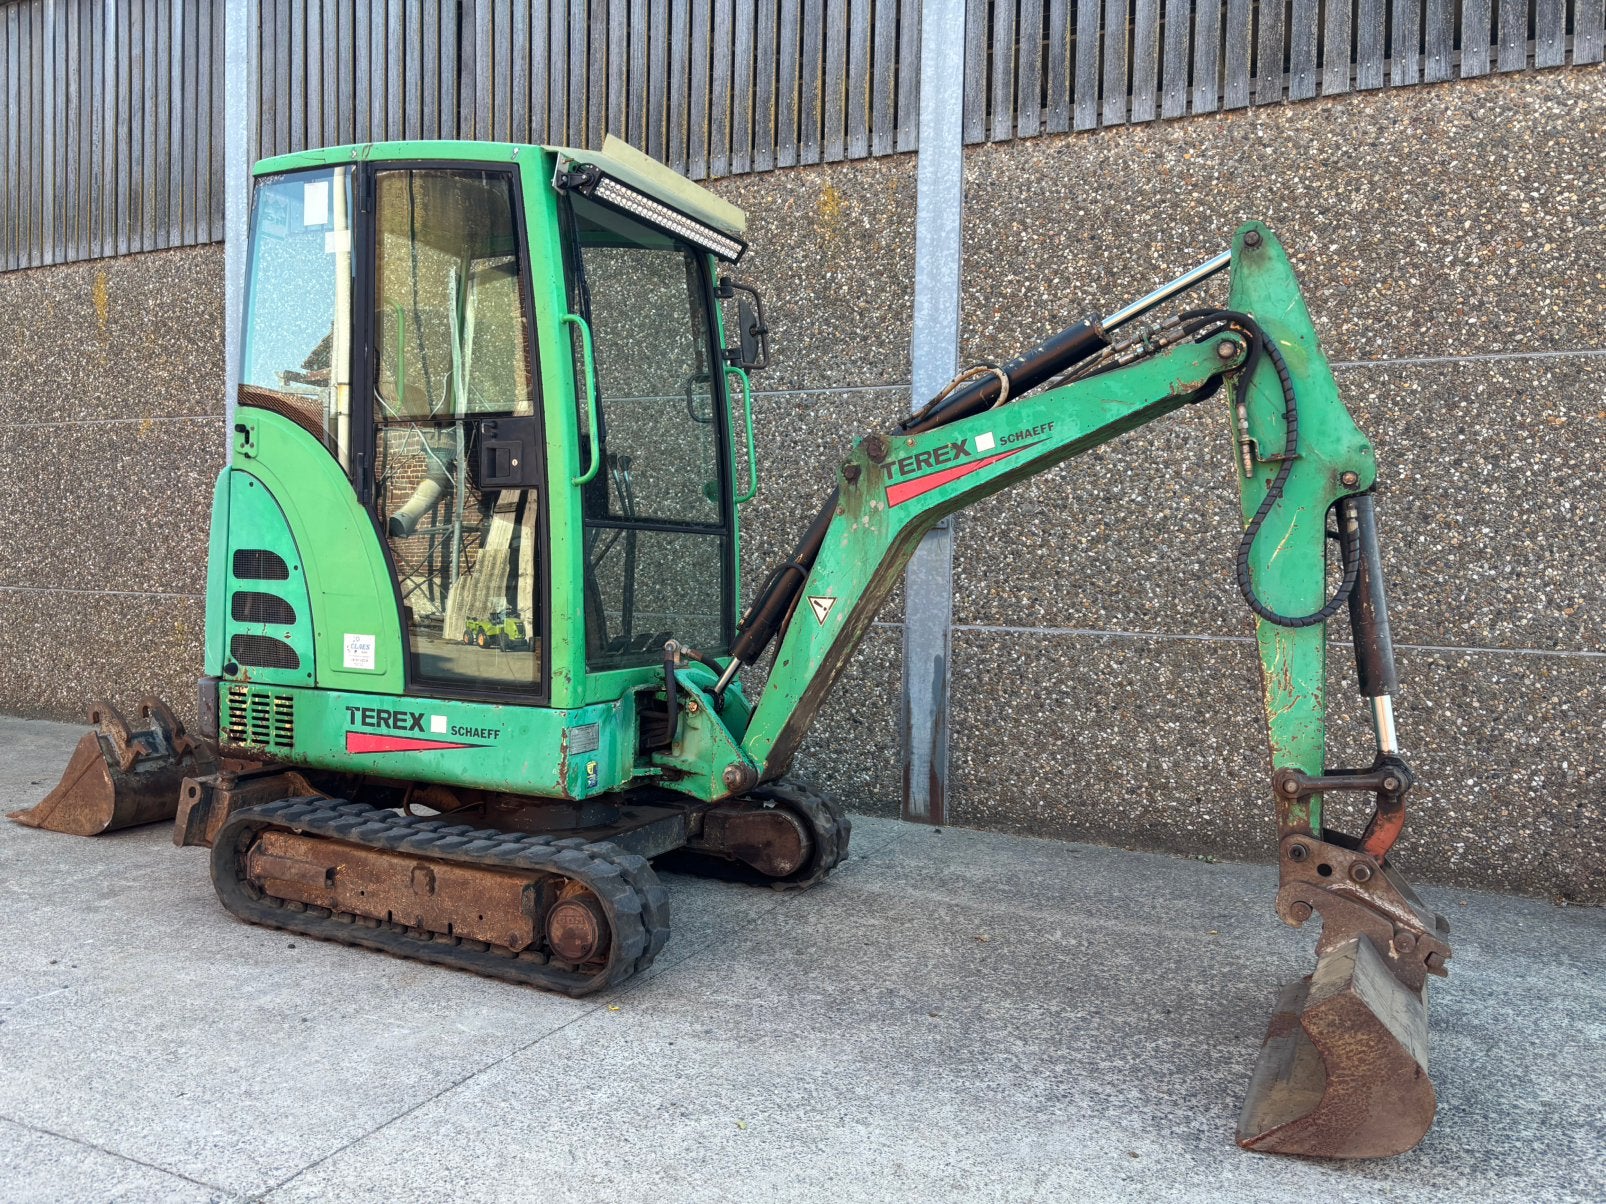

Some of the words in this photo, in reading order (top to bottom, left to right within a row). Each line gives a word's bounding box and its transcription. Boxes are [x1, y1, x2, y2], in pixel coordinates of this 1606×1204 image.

[880, 438, 972, 480] TEREX
[1000, 421, 1055, 446] SCHAEFF
[346, 706, 425, 733] TEREX
[451, 725, 500, 740] SCHAEFF
